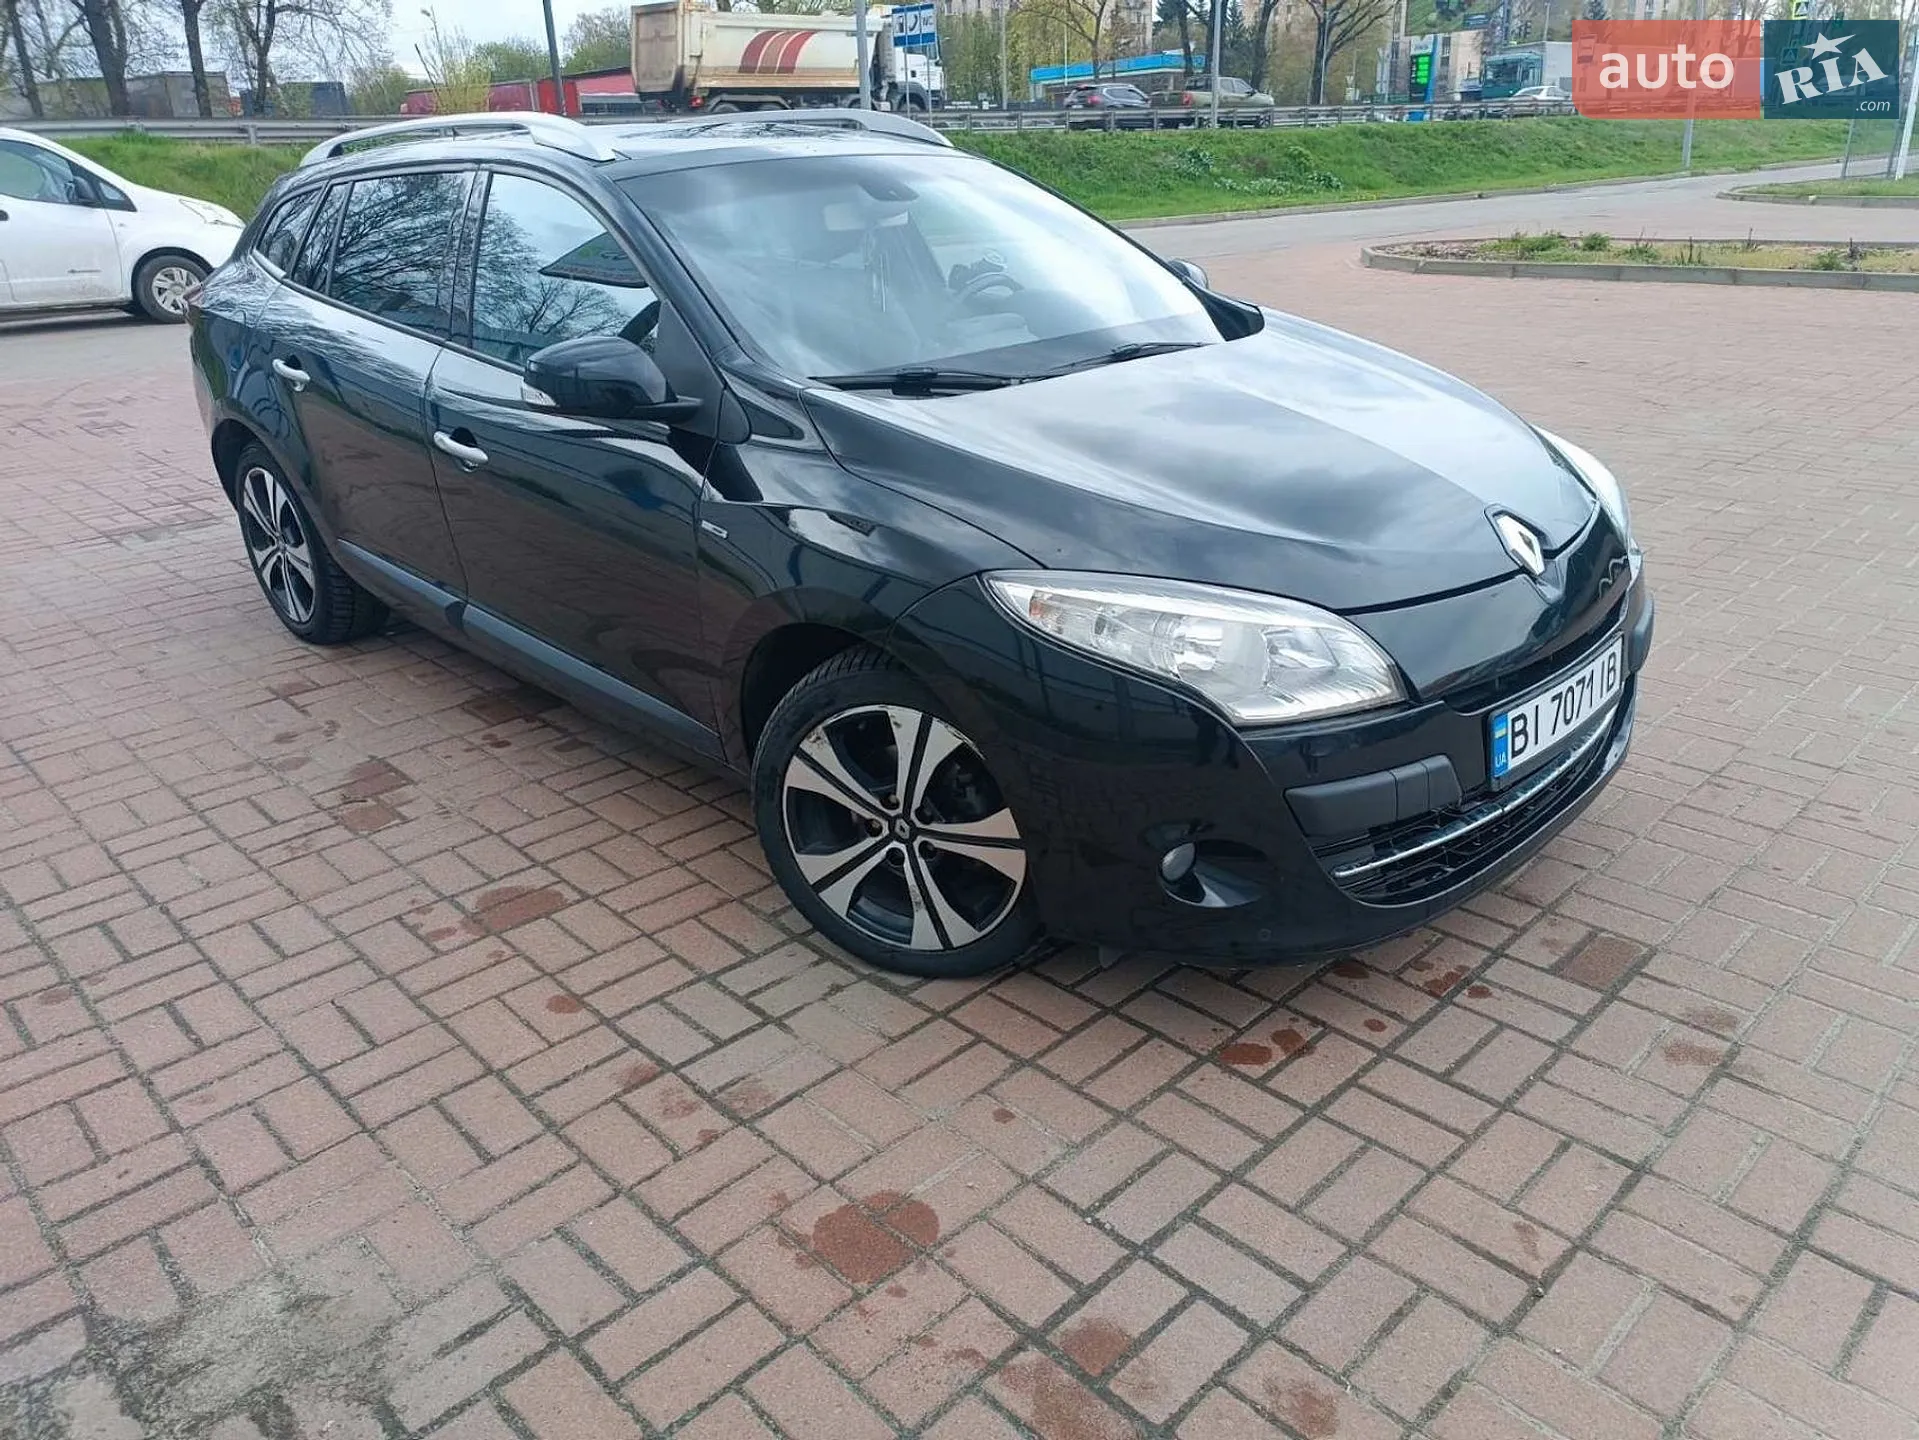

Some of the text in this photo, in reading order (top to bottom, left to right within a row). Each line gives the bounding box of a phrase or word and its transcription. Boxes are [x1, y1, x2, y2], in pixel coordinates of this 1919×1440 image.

[1511, 650, 1618, 759] BI 7071 IB
[1494, 754, 1507, 769] UA
